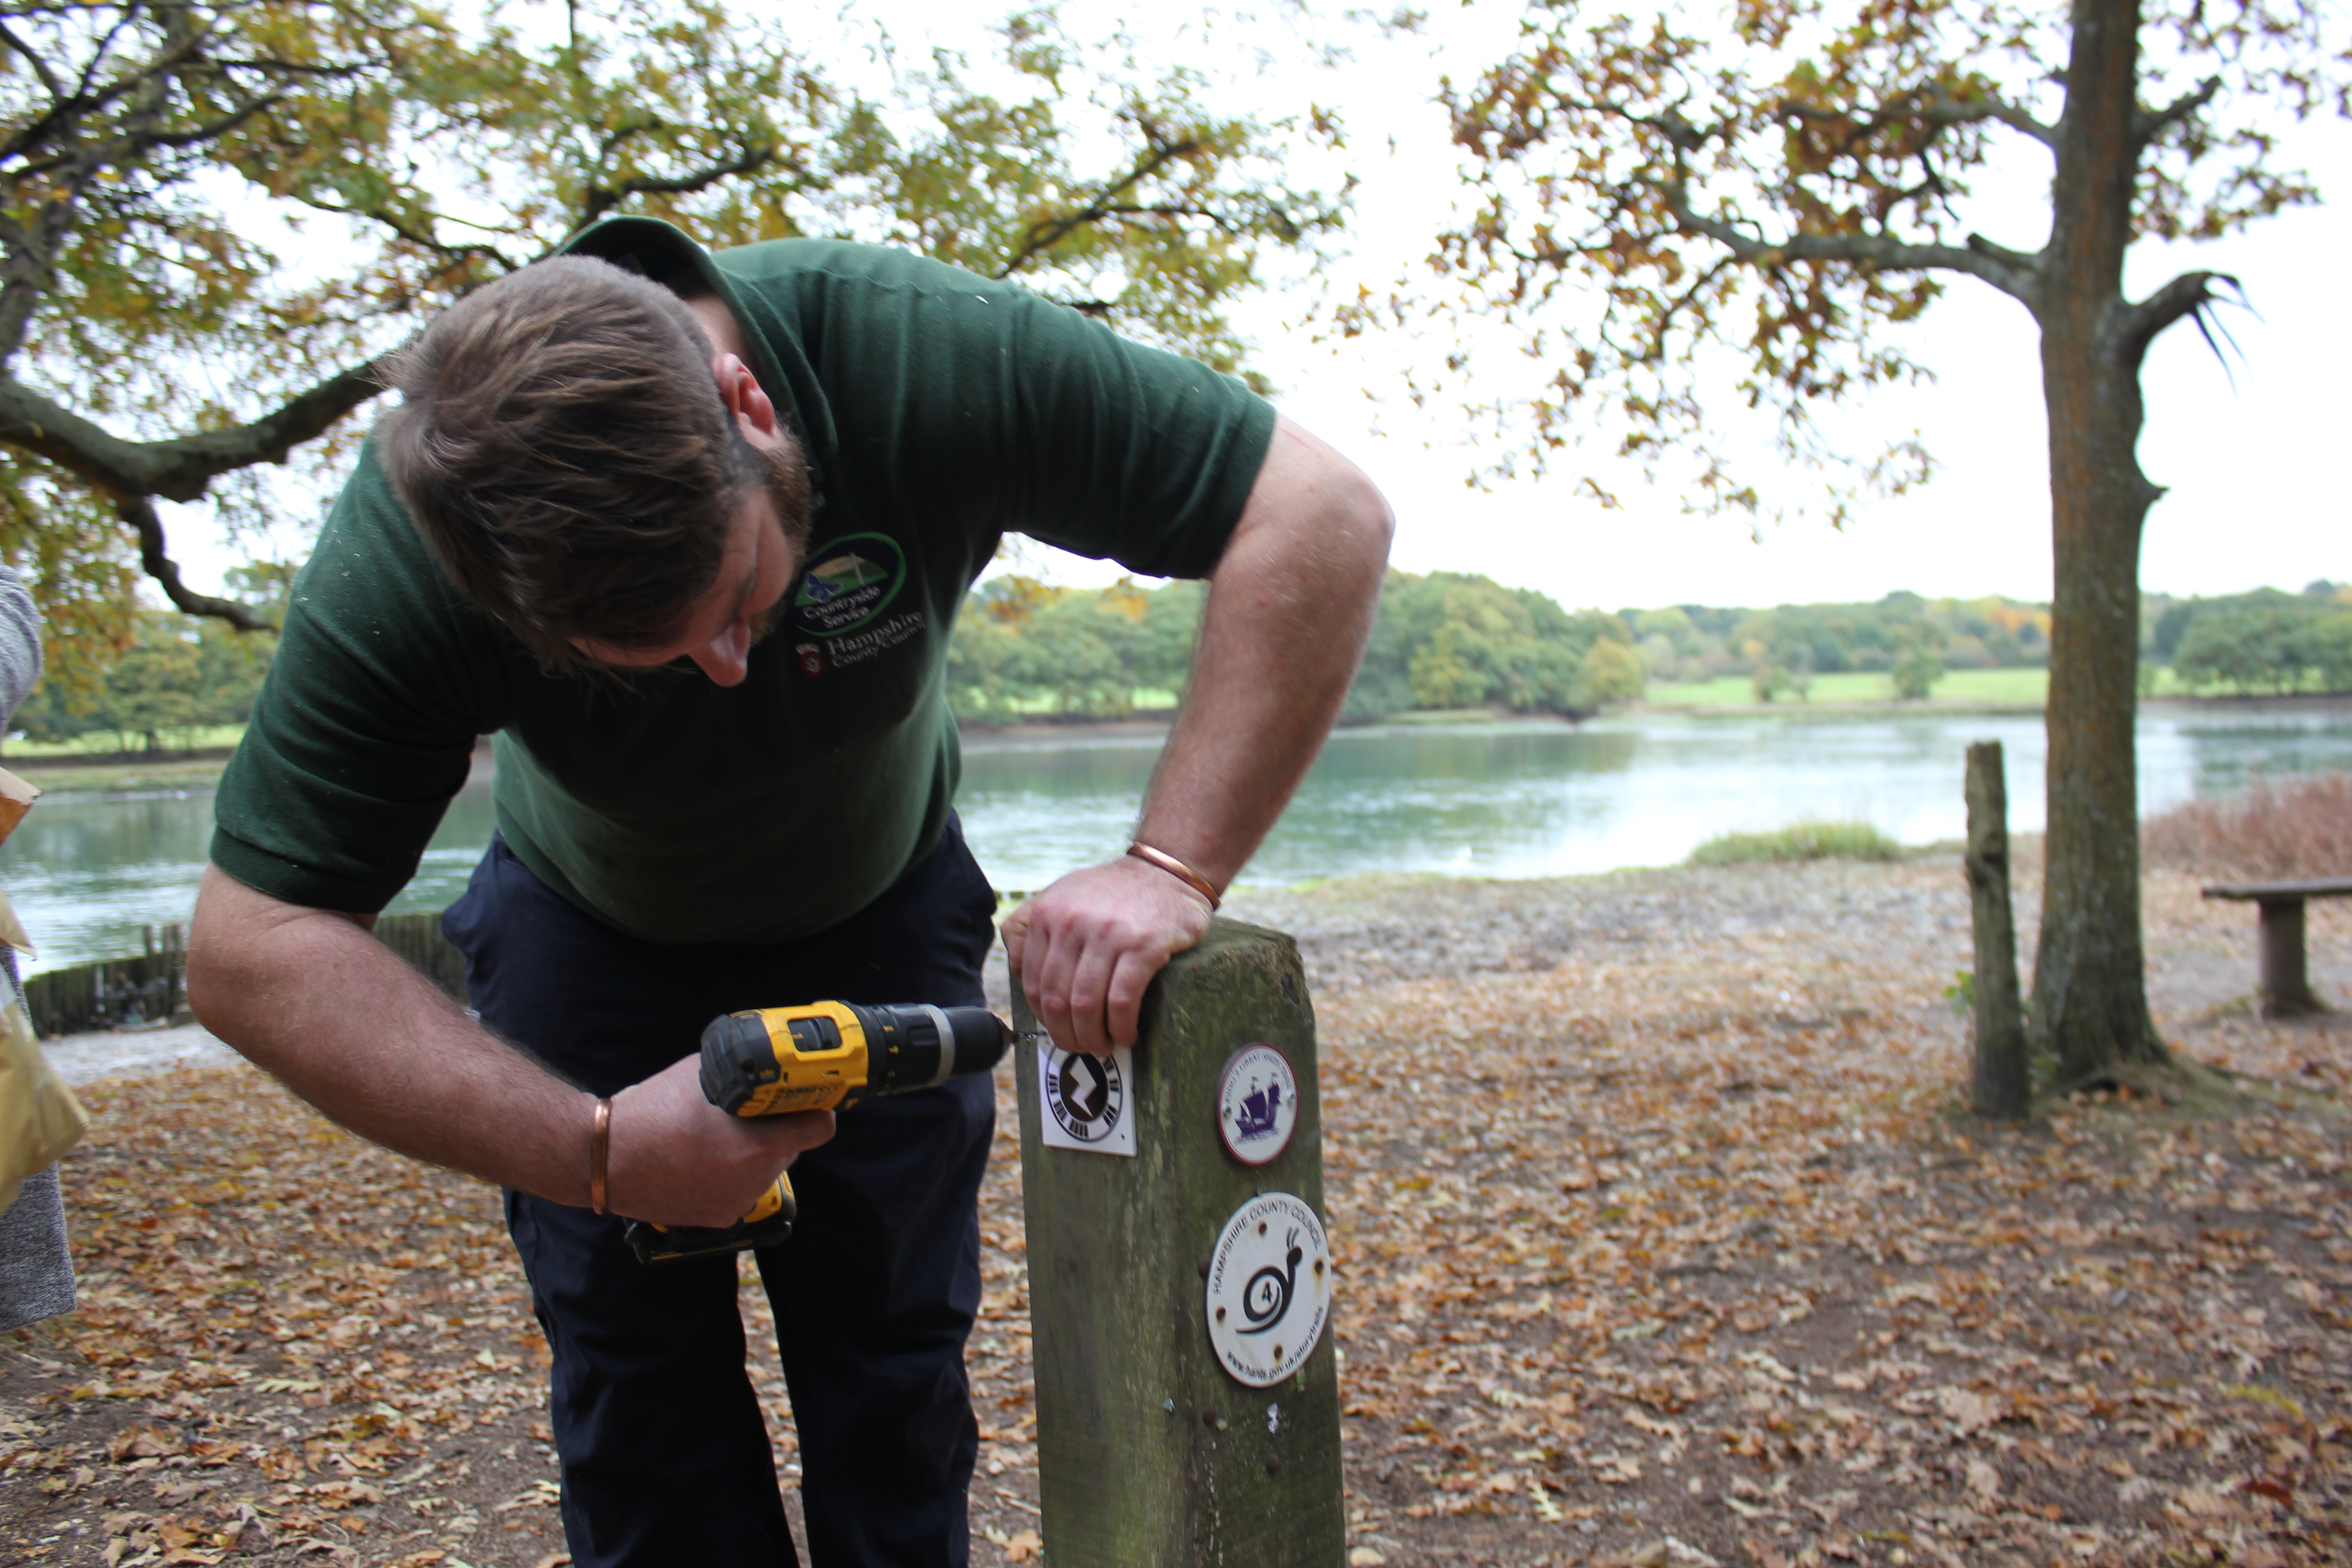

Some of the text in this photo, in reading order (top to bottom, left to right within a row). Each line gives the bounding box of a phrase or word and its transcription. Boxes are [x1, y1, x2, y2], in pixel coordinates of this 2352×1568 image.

[822, 607, 870, 629] Service
[825, 612, 923, 656] Hampshire
[831, 645, 879, 668] County
[1212, 1200, 1321, 1295] HAMPSHIRE COUNTY COUNCIL
[1261, 1281, 1273, 1304] 4
